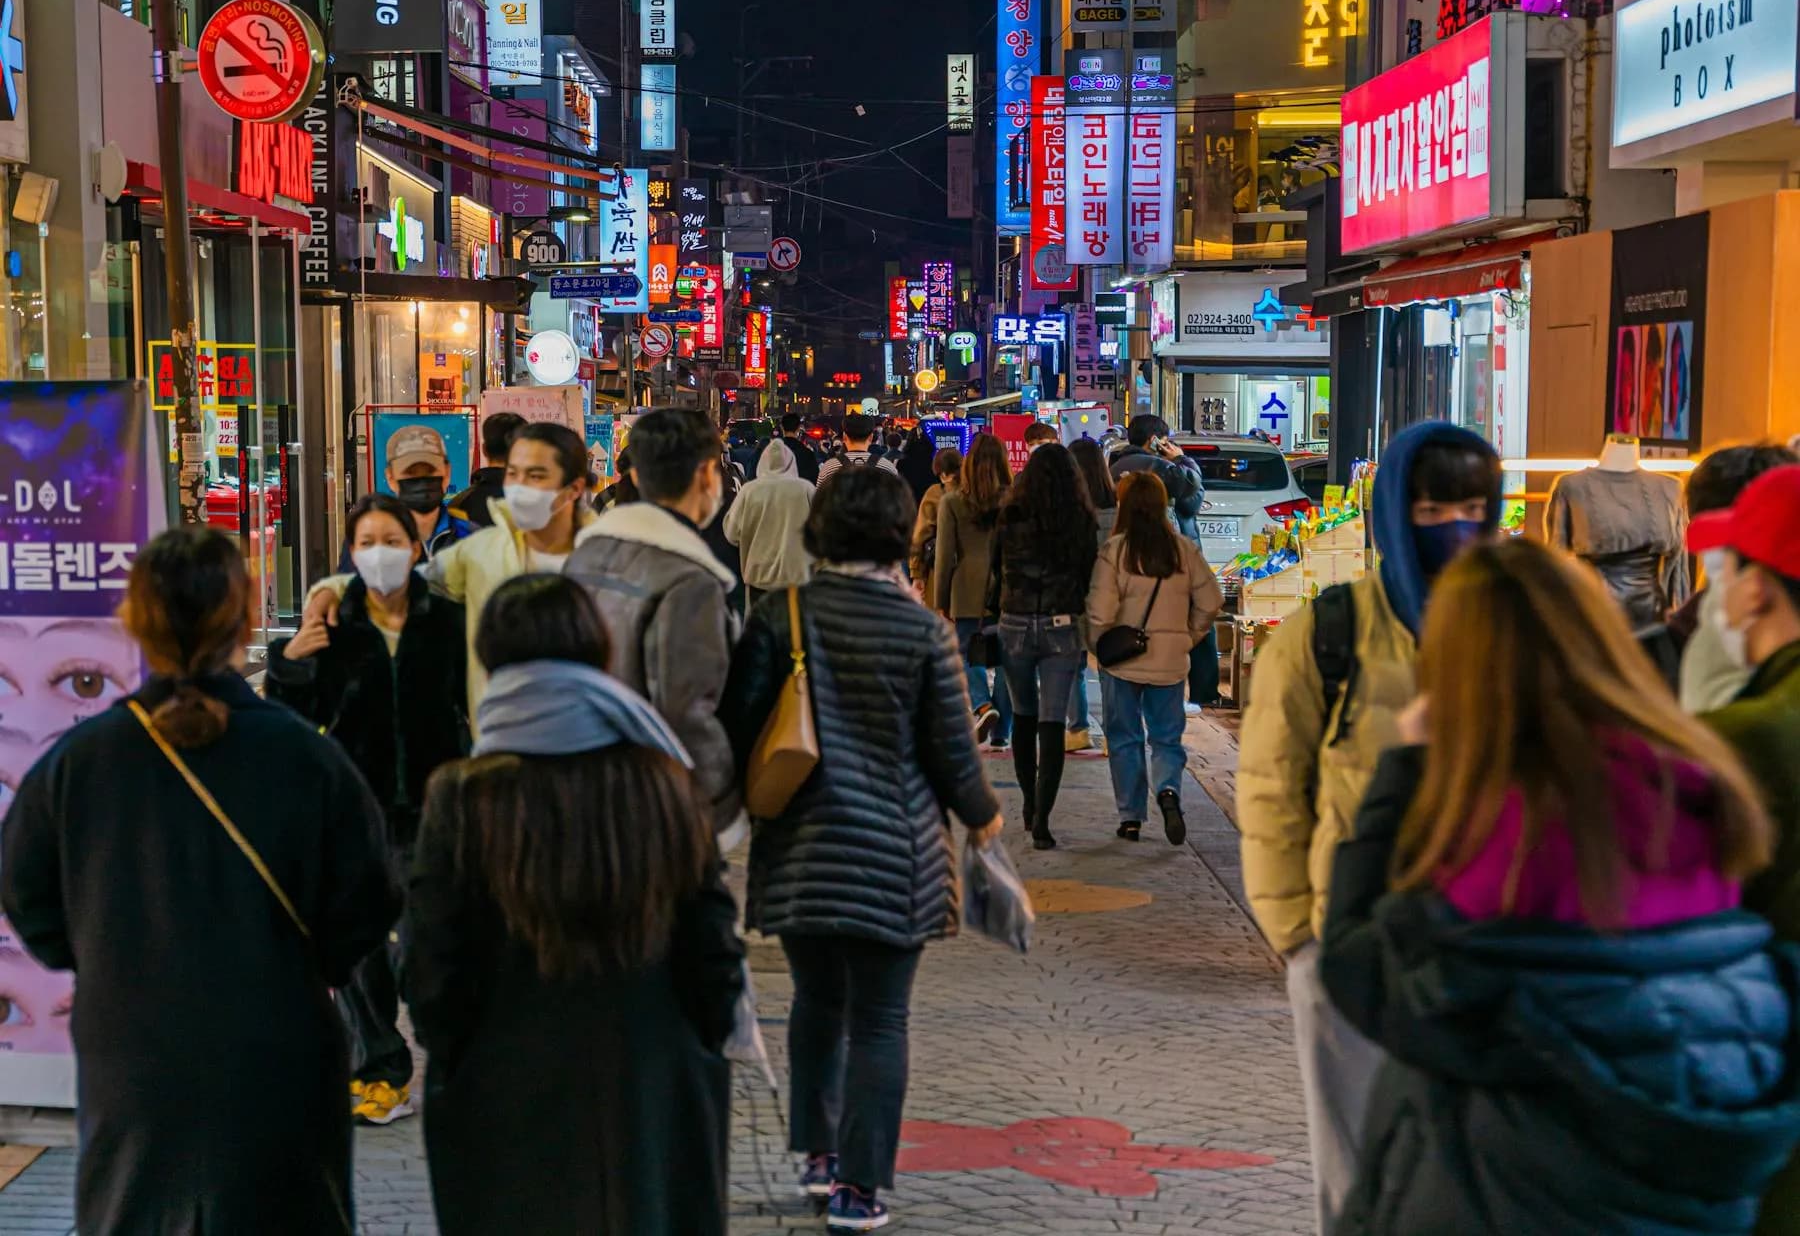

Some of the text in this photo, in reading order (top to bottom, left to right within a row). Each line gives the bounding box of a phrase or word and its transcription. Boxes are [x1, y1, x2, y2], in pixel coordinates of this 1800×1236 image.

[243, 1, 306, 52] NOSMOKING
[1079, 9, 1121, 20] BAGEL
[1674, 55, 1734, 108] BOX
[1359, 76, 1468, 207] 세계과자할인점
[1082, 114, 1108, 257] 코인노래방
[305, 206, 329, 283] COFFEE
[527, 244, 560, 263] 900
[1187, 313, 1252, 325] 02)924-3400
[1253, 288, 1285, 332] 수
[955, 336, 972, 345] CU
[1260, 392, 1288, 429] 수
[1200, 522, 1232, 534] 7526
